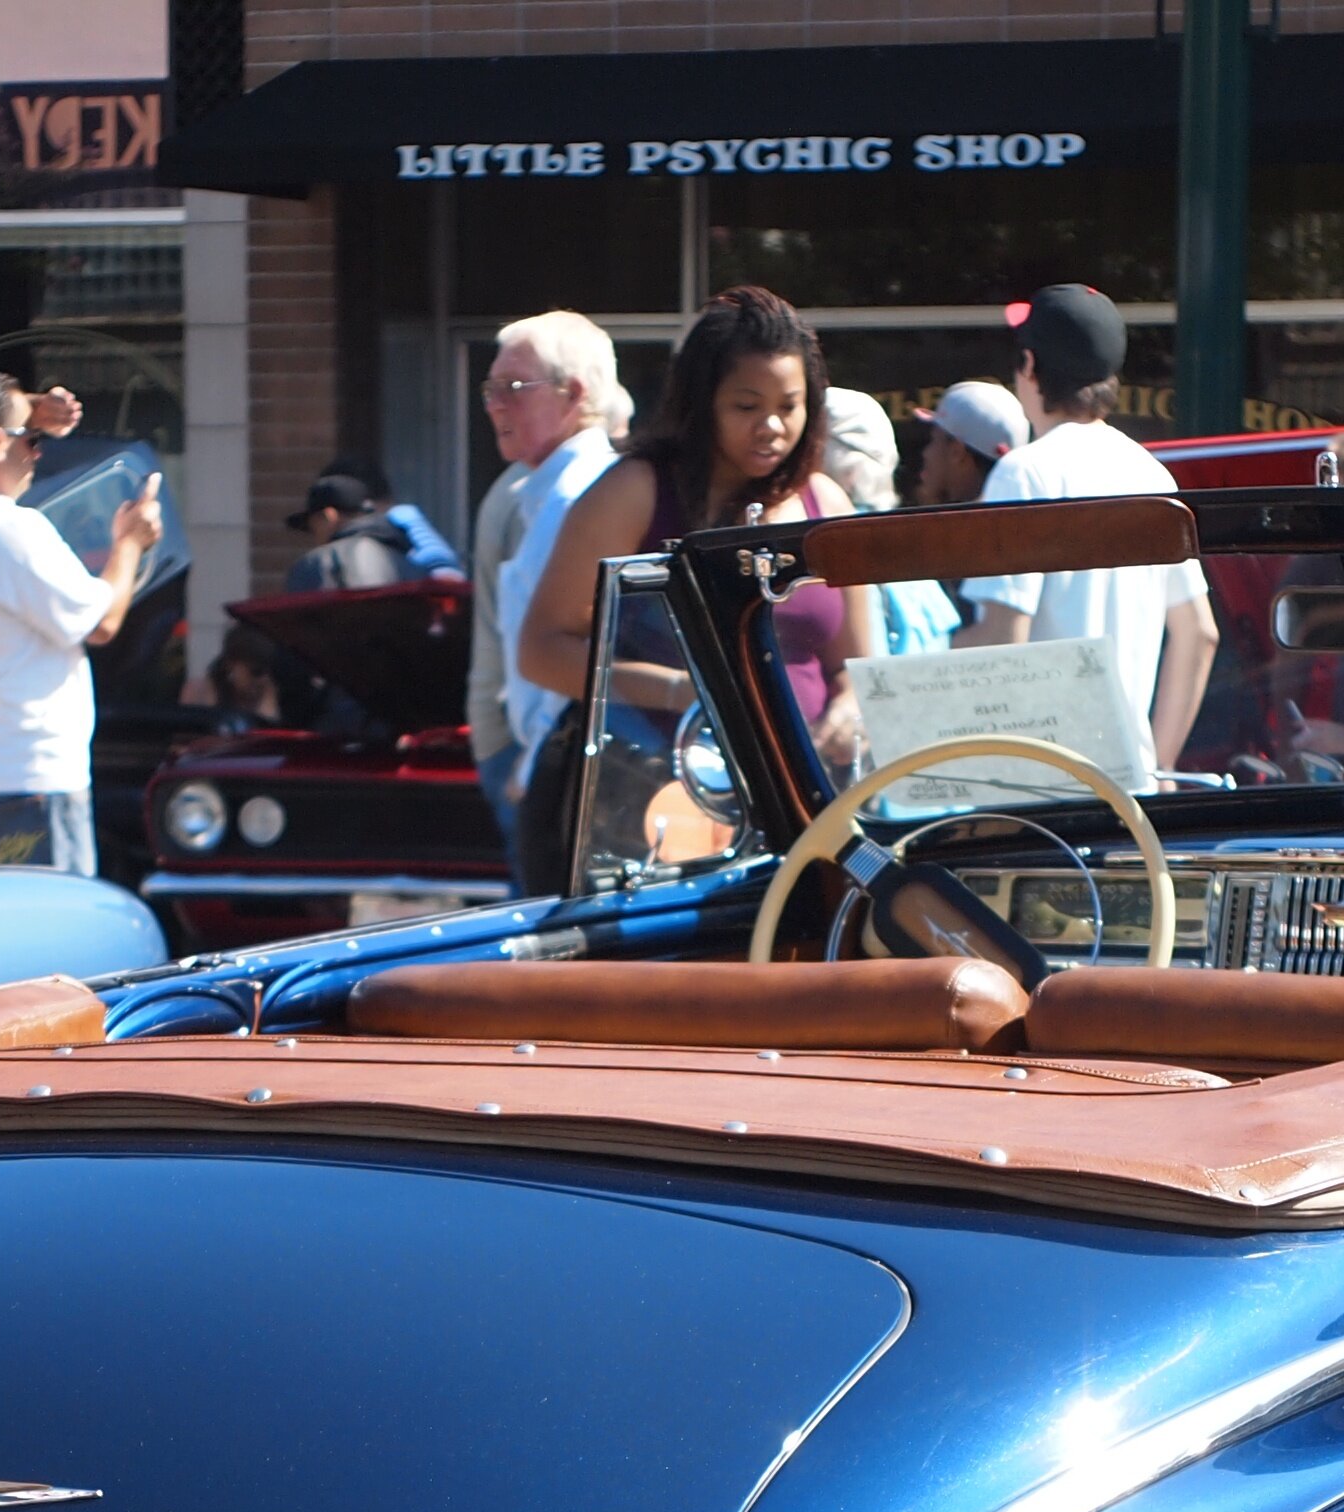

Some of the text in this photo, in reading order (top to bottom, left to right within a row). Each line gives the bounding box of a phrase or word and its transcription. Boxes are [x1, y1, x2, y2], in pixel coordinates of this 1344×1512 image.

[395, 132, 1086, 179] LITTLE PSYCHIC SHOP
